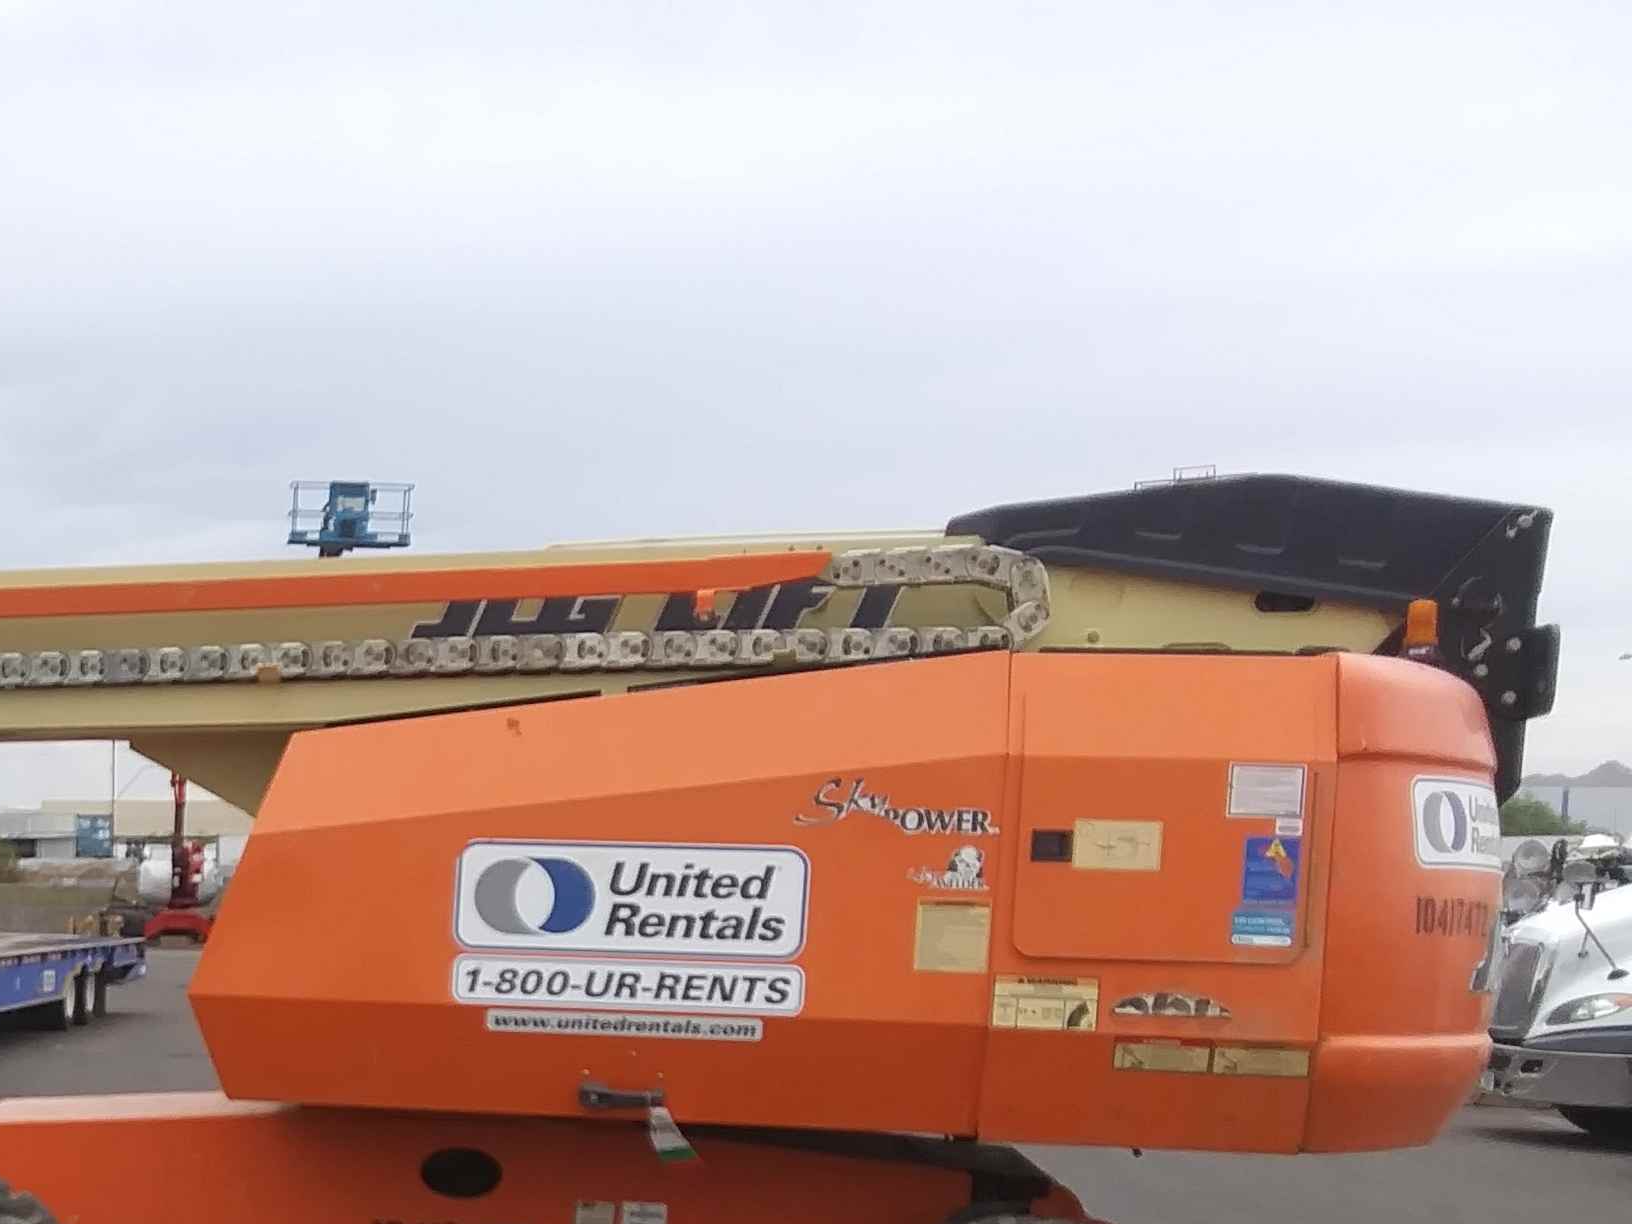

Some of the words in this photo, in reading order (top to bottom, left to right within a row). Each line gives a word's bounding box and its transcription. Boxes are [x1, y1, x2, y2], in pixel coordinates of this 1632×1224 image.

[609, 860, 776, 900] United
[604, 902, 786, 942] Rentals
[464, 967, 792, 1004] 1-800-UR-RENTS
[493, 1013, 758, 1038] www.unitedrentals.com
